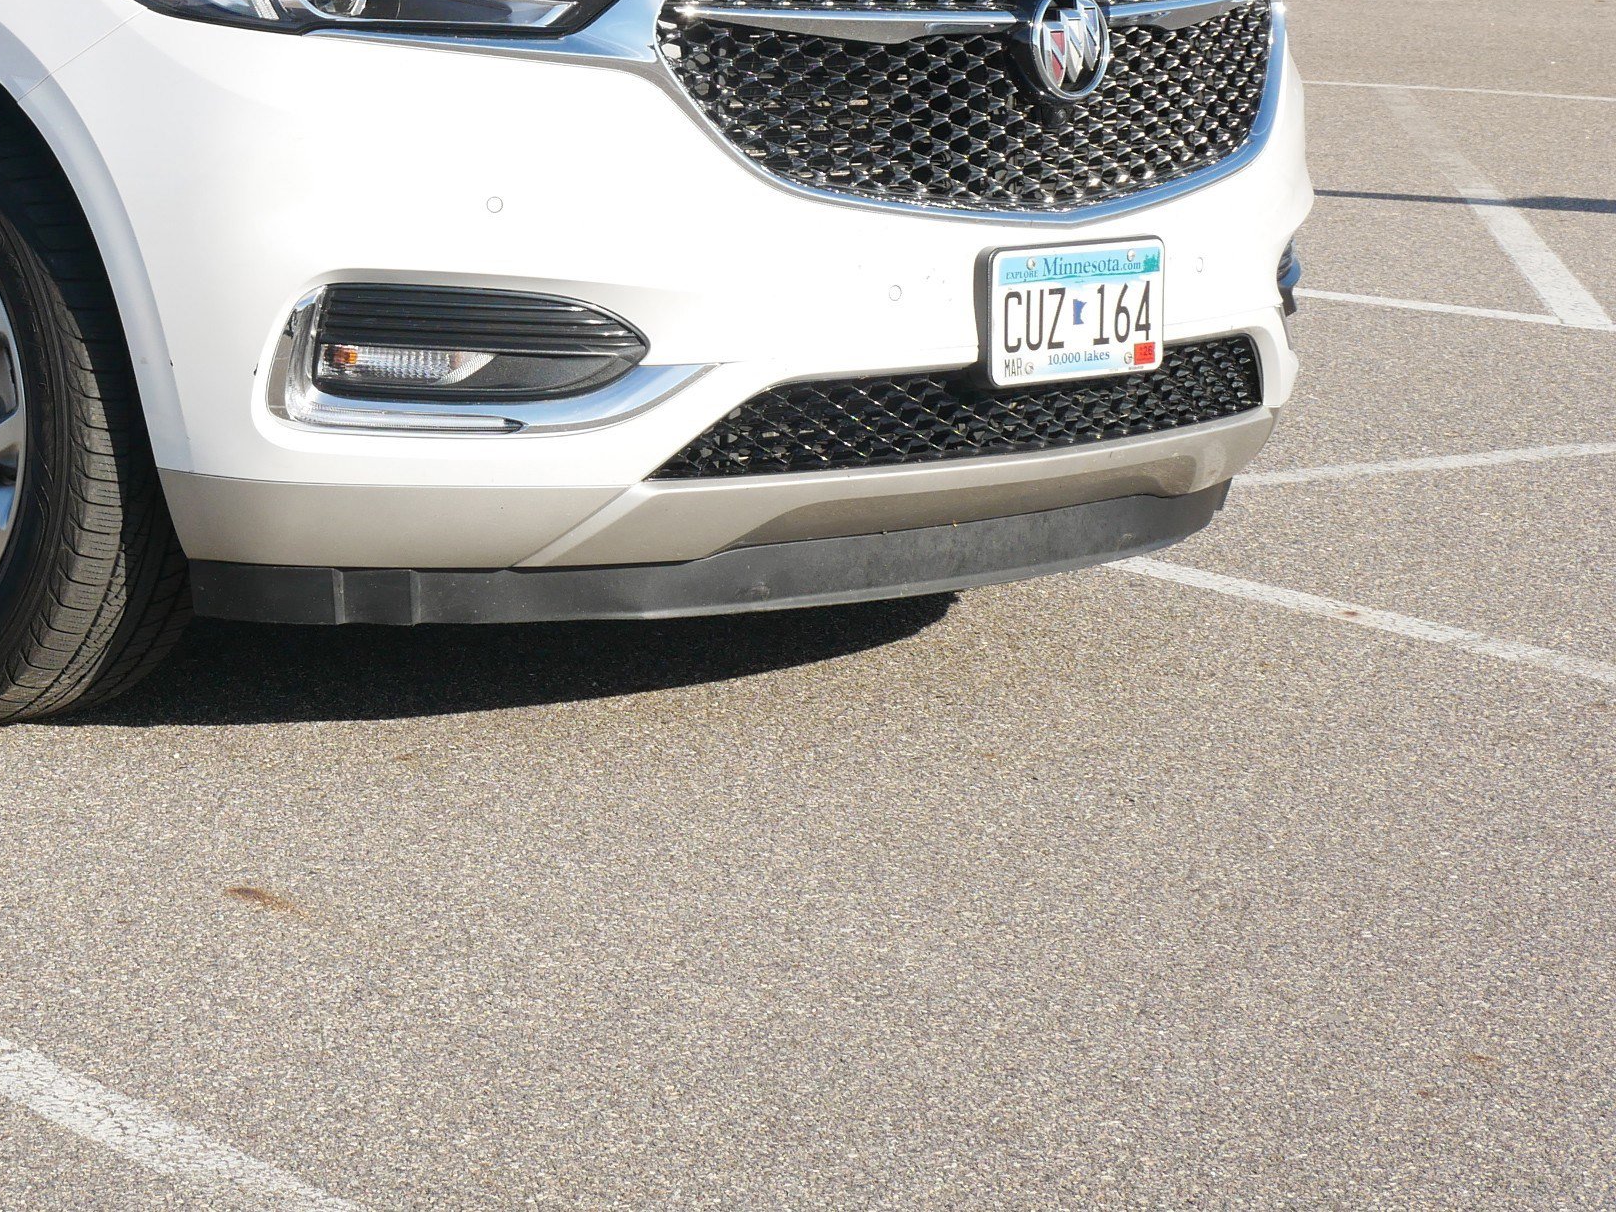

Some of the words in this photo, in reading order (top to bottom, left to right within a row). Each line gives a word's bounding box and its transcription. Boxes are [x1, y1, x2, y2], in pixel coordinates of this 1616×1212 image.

[1005, 270, 1039, 280] EXPLORE
[1042, 257, 1142, 277] Minnesota.com
[1004, 287, 1066, 353] CUZ
[1093, 280, 1152, 346] 164
[1004, 358, 1023, 378] MAR
[1047, 351, 1081, 366] 10,000
[1083, 349, 1110, 362] lakes
